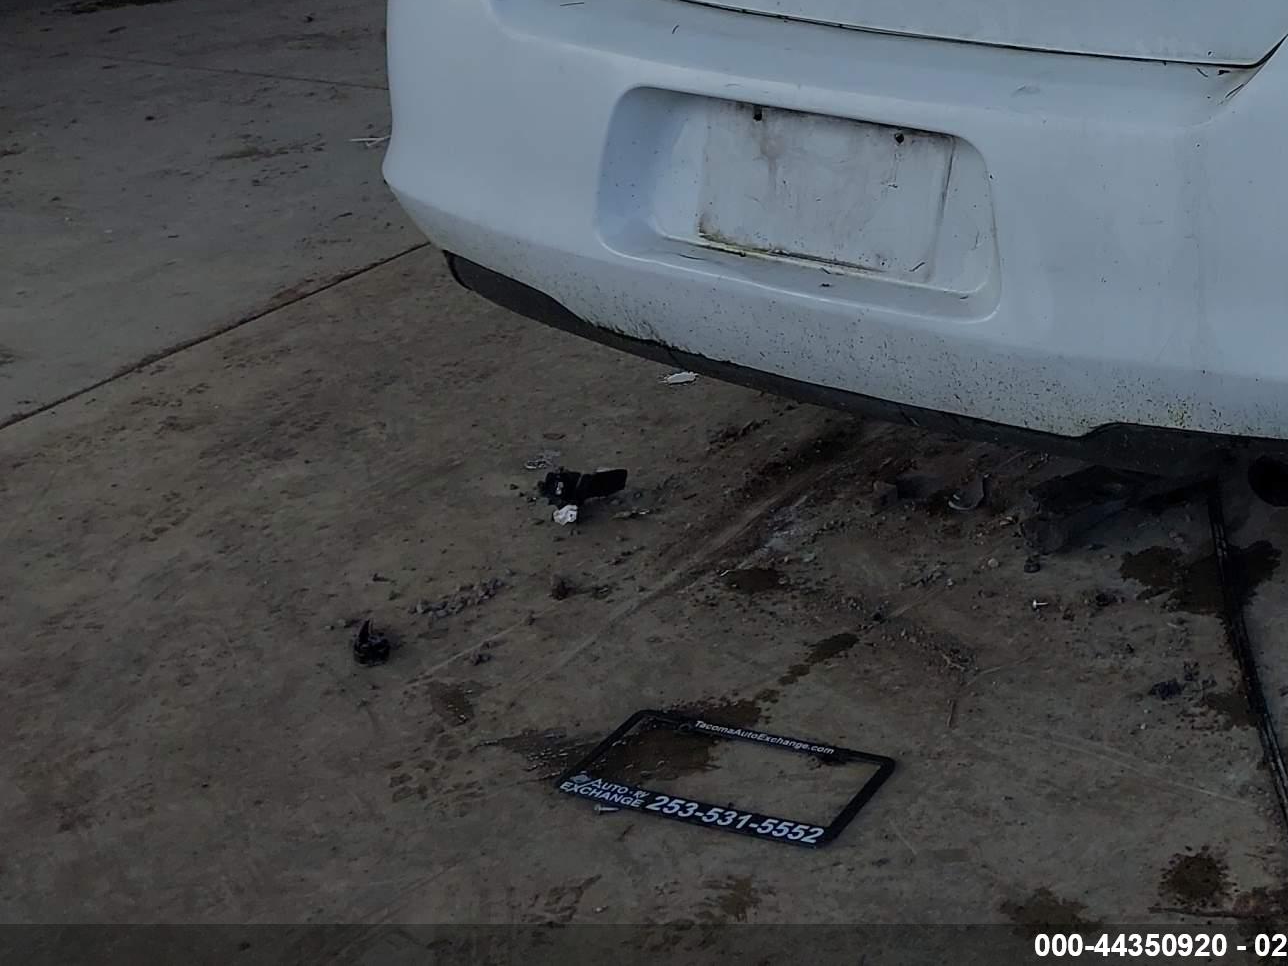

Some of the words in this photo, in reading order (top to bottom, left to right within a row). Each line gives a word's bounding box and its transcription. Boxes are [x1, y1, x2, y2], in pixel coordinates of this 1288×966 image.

[694, 720, 835, 755] TacomaAutoExchange.com
[560, 781, 645, 808] EXCHANGE
[645, 795, 825, 845] 253-531-5552
